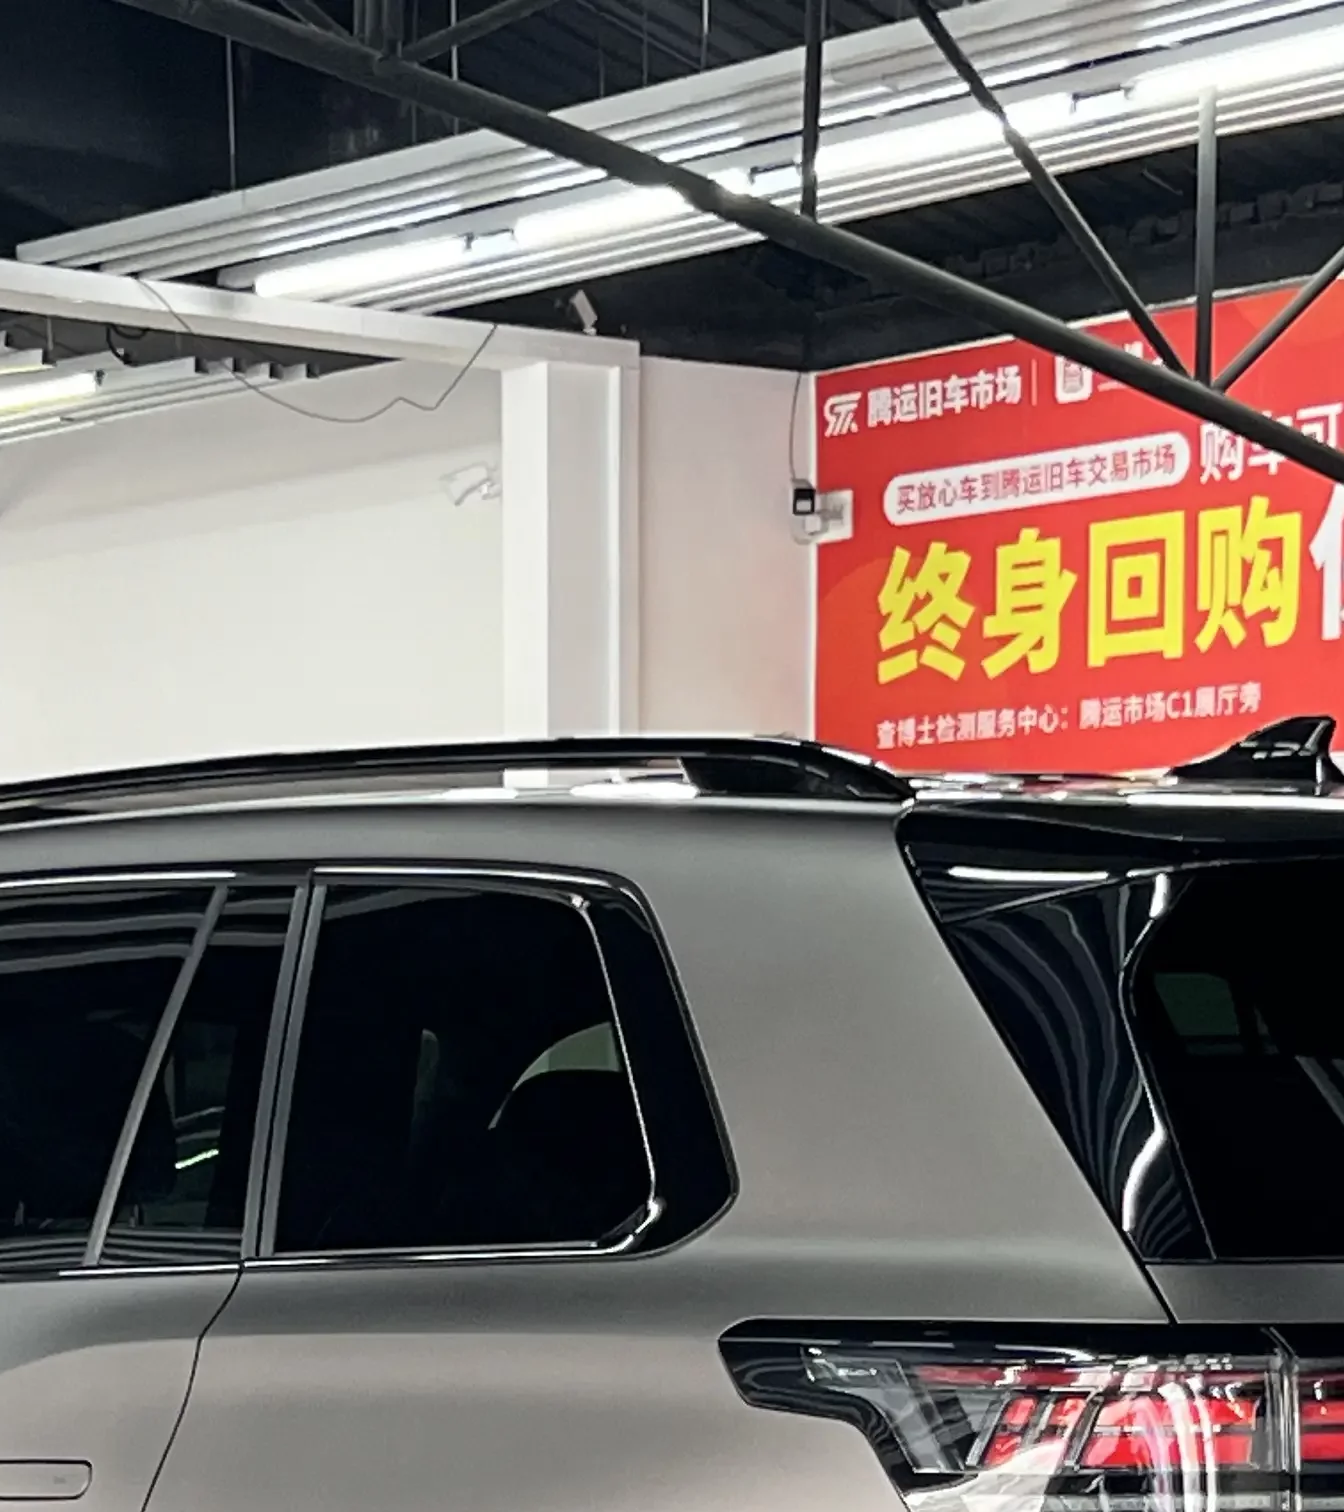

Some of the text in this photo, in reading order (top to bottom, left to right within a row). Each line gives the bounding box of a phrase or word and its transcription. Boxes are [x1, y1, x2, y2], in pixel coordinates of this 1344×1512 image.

[866, 364, 1022, 428] 腾运旧车市场
